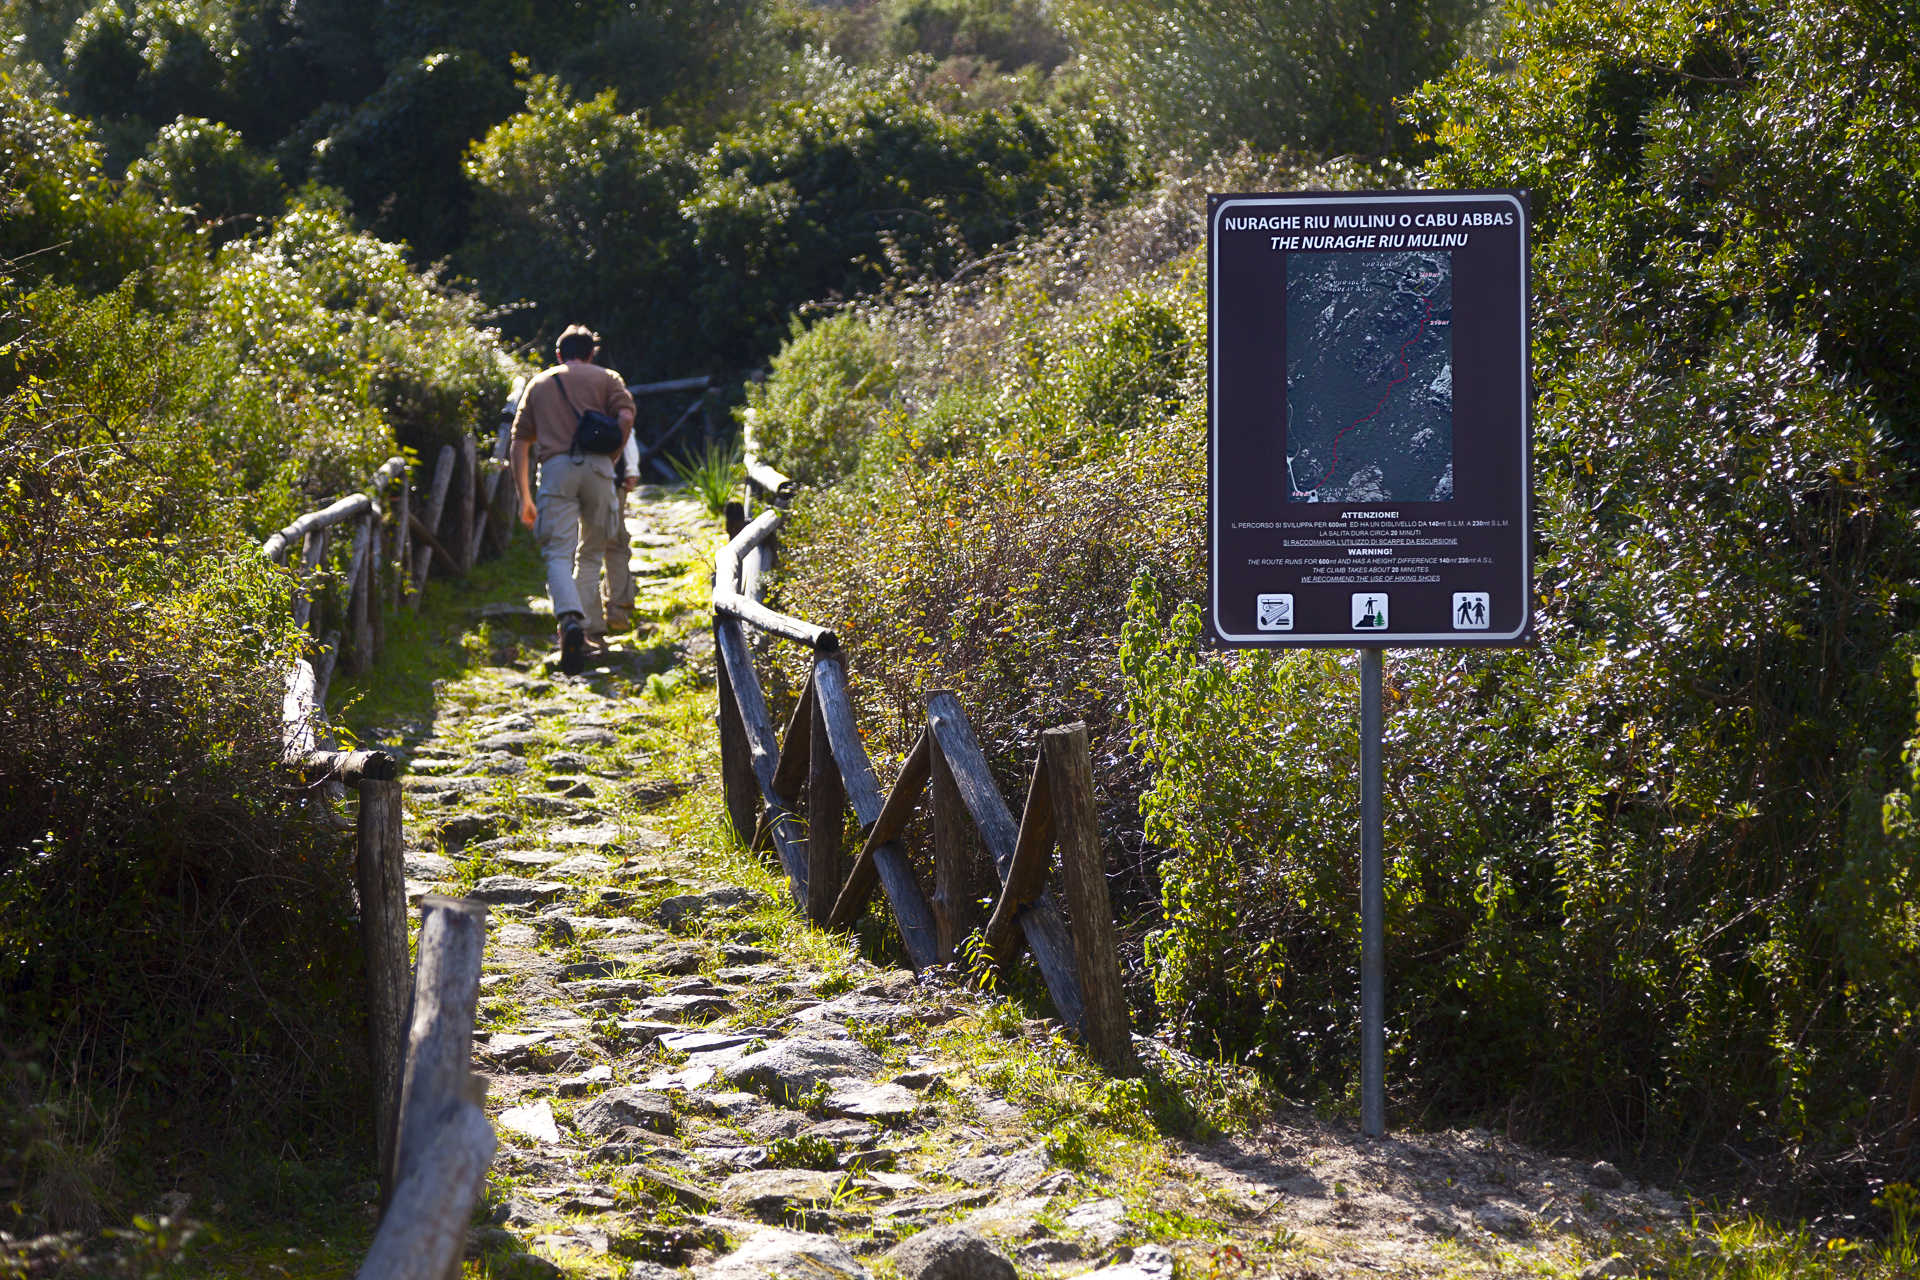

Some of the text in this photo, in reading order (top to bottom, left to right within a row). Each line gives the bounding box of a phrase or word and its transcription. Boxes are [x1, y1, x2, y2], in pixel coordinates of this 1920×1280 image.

[1226, 213, 1513, 230] NURAGHE RIU MULINU O CABU ABBAS
[1271, 234, 1468, 249] THE NURAGHE RIU MULINU
